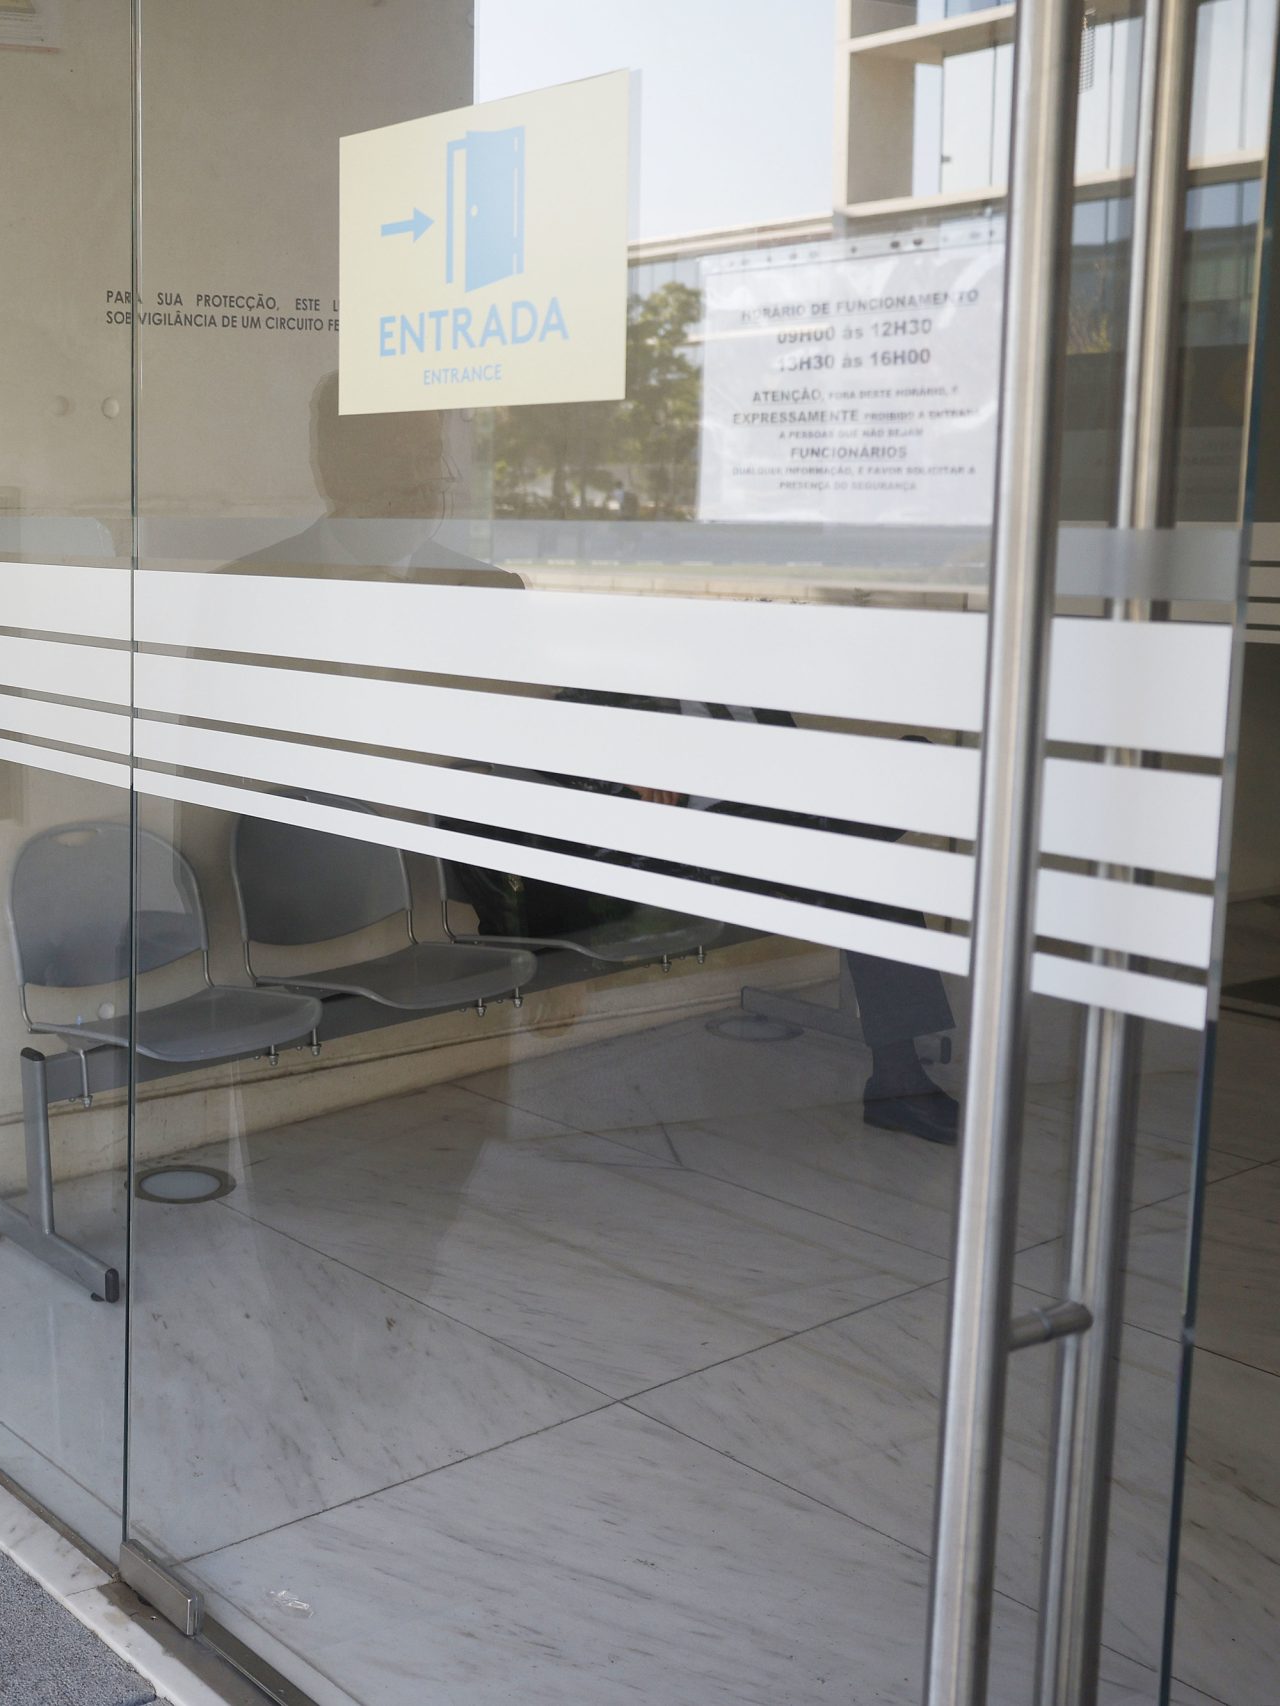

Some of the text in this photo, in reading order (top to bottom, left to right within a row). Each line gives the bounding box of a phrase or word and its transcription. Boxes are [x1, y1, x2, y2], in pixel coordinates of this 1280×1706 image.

[106, 290, 142, 304] PARA
[157, 292, 183, 306] SUA
[196, 293, 279, 311] PROTECÇÃO,
[295, 298, 320, 311] ESTE
[811, 302, 831, 316] DE
[138, 310, 217, 328] VIGILÂNCIA
[222, 315, 237, 328] DE
[241, 315, 261, 329] UM
[265, 316, 323, 331] CIRCUITO
[379, 297, 569, 357] ENTRADA
[871, 317, 932, 337] 12H30
[870, 348, 931, 366] 16H00
[423, 364, 502, 385] ENTRANCE
[733, 409, 859, 425] EXPRESSAMENTE
